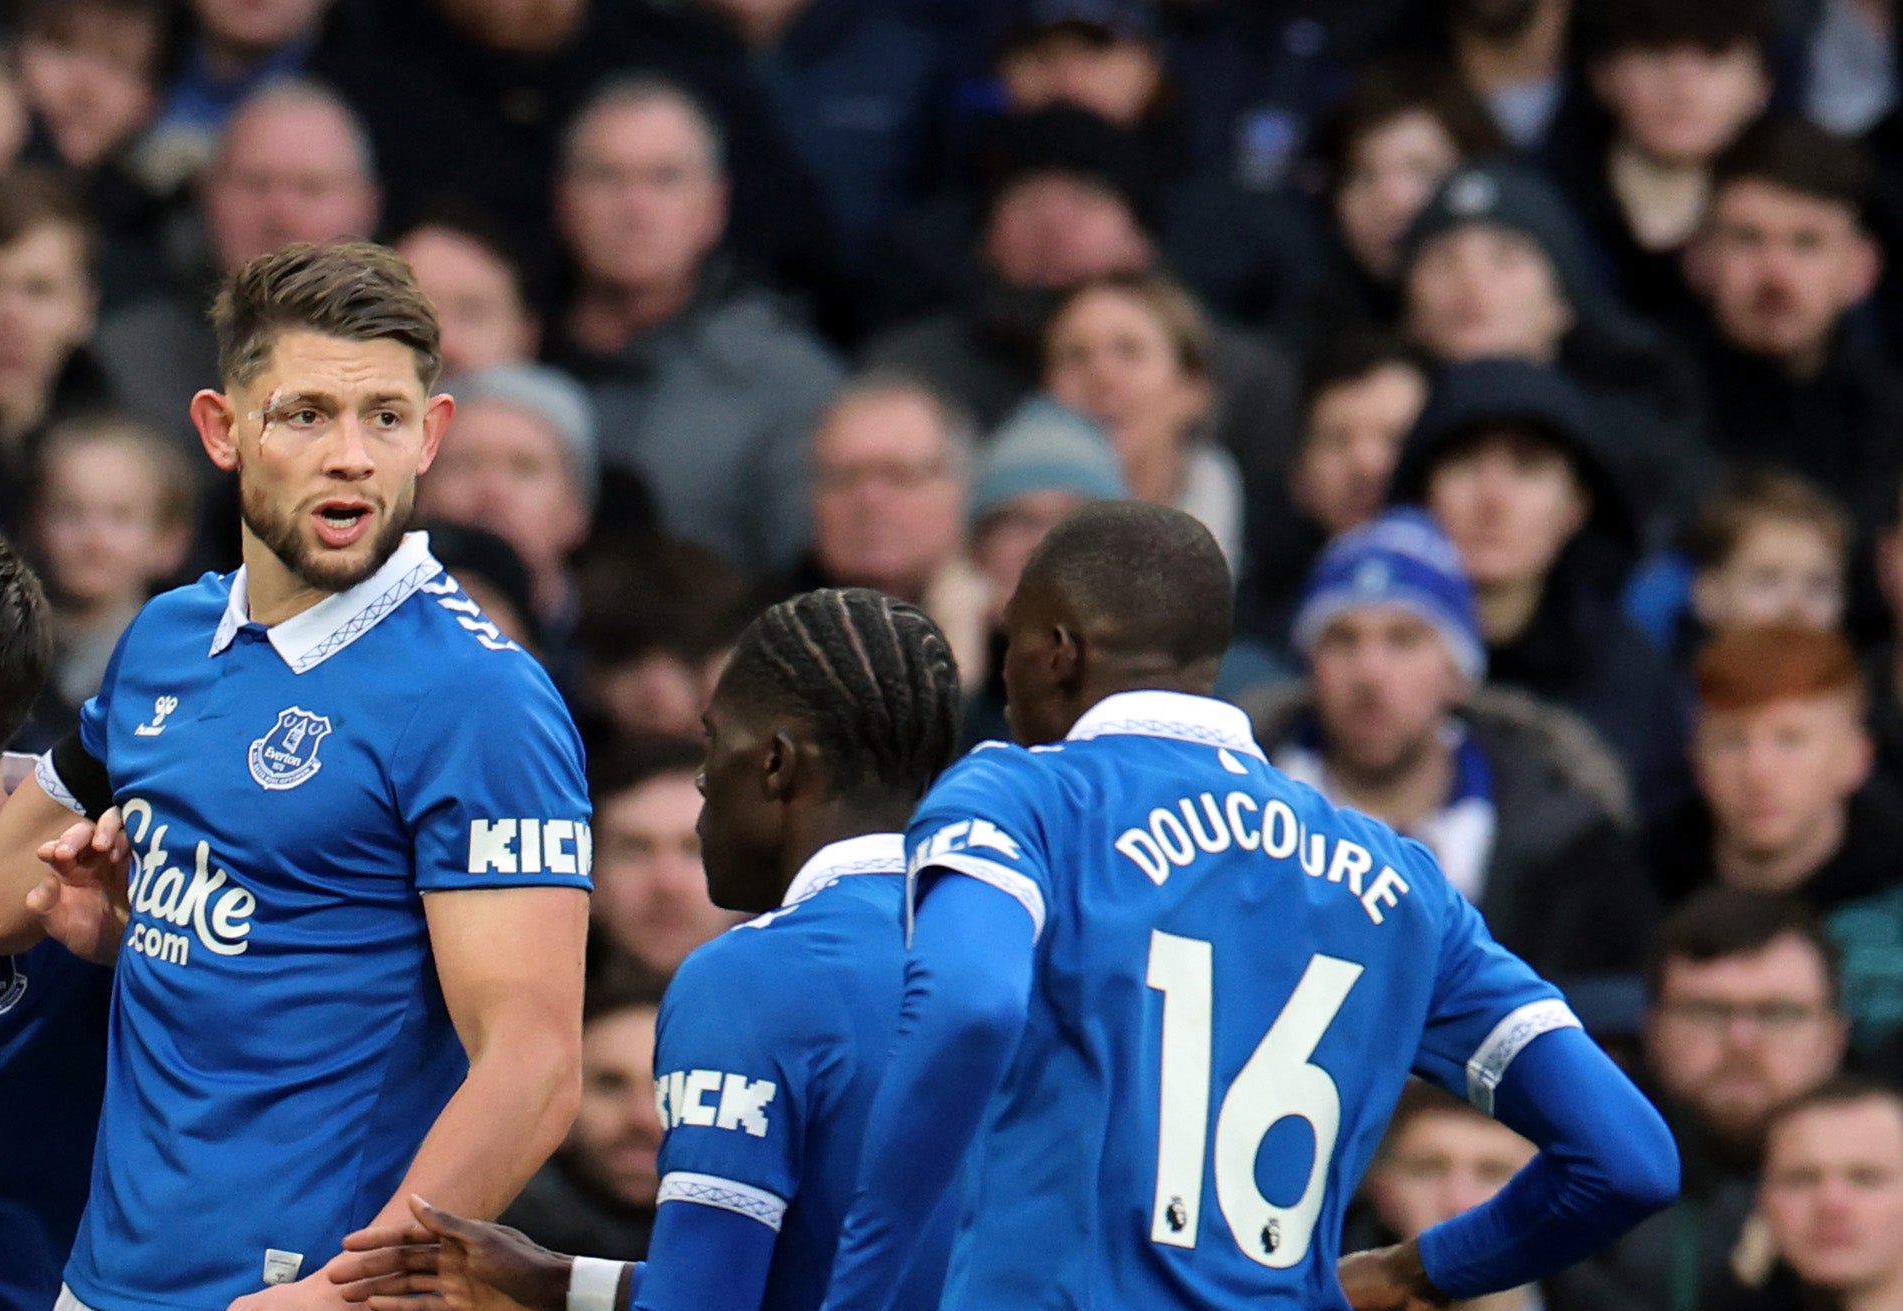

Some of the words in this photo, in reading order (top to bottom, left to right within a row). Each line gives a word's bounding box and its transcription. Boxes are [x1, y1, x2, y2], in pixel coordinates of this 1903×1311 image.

[264, 746, 302, 767] Everton
[1114, 791, 1410, 927] DOUCOURE
[1146, 929, 1365, 1269] 16
